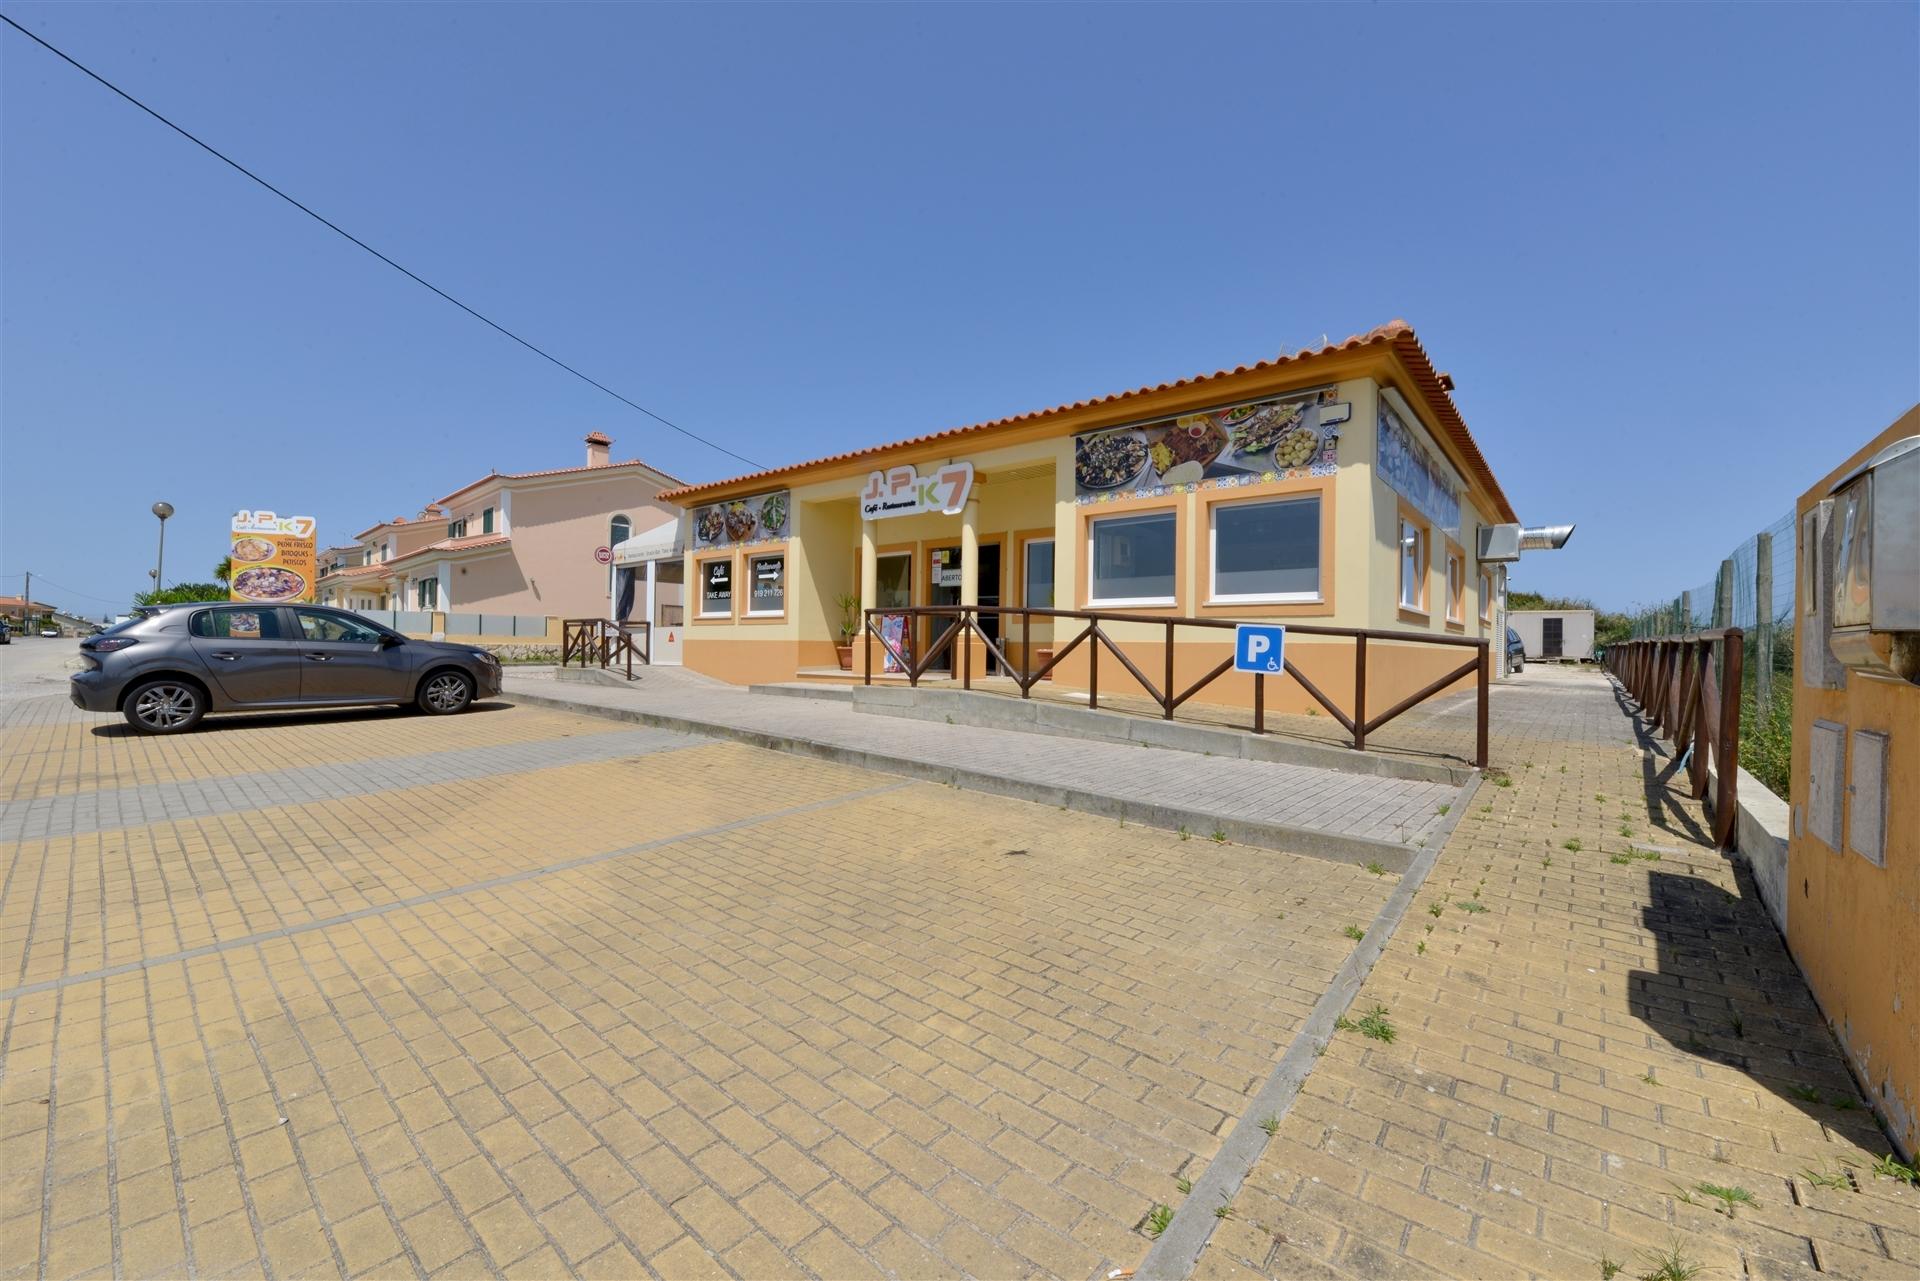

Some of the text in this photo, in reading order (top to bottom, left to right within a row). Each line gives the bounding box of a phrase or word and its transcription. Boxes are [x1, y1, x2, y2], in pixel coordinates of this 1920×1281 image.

[864, 504, 879, 514] Café
[293, 541, 313, 549] FRESCO
[713, 565, 725, 577] Café
[706, 591, 718, 599] TAKE
[764, 589, 773, 597] 211
[1248, 634, 1270, 662] P
